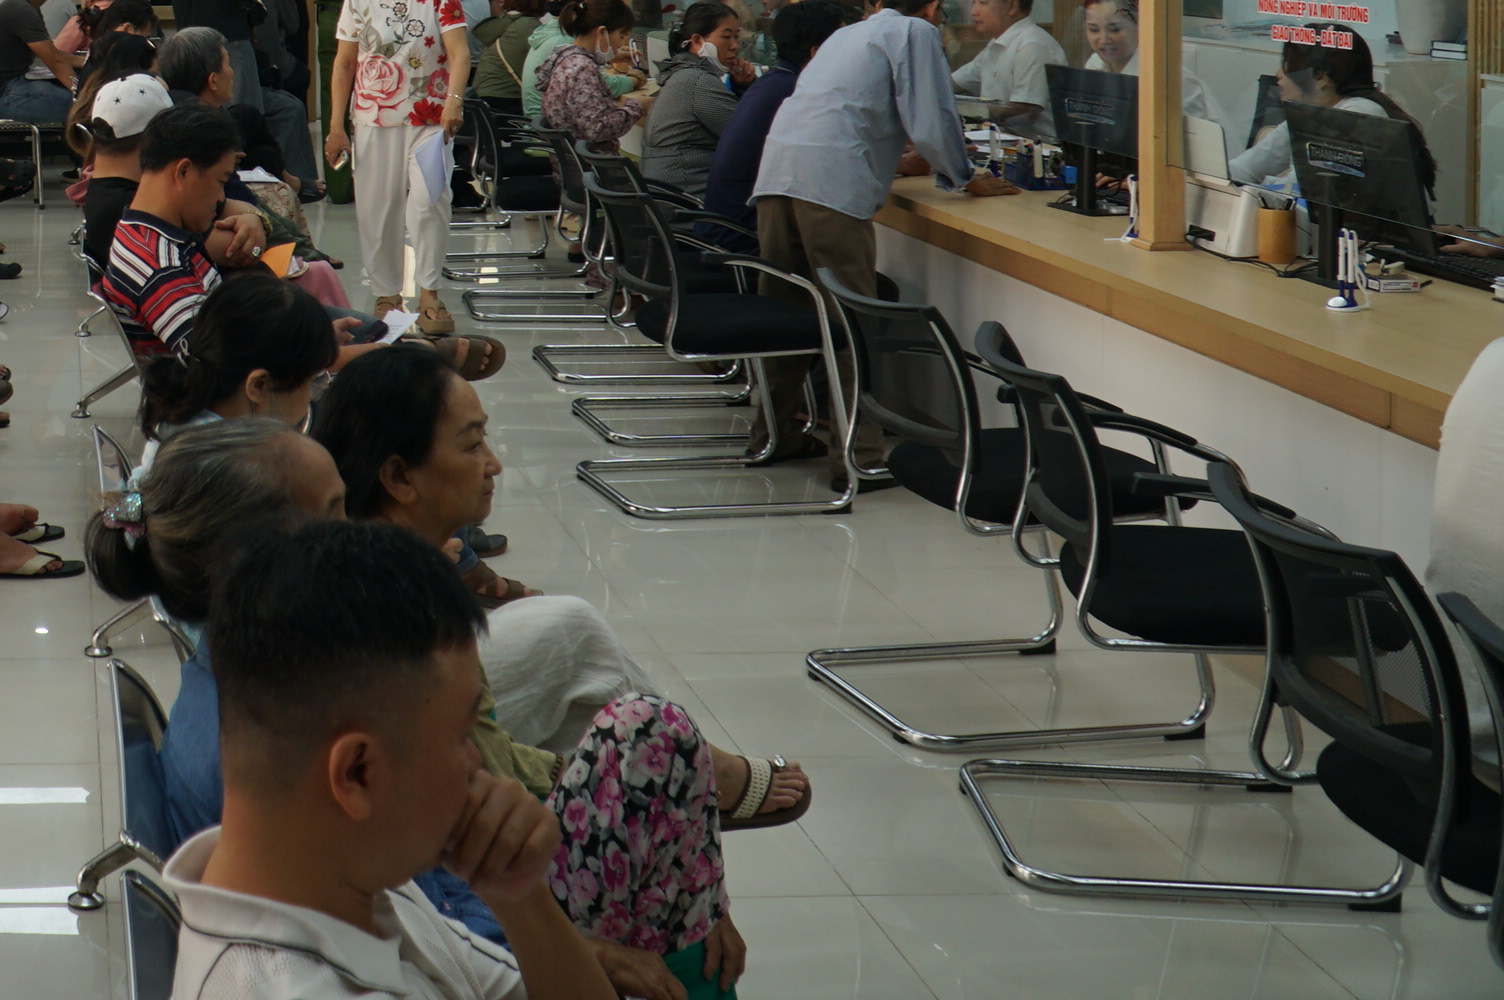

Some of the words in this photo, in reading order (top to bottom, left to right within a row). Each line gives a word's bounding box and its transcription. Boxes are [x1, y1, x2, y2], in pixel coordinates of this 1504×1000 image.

[1308, 0, 1318, 18] VÀ
[1320, 1, 1335, 20] MÔI
[1337, 2, 1369, 24] TRƯỜNG
[1271, 25, 1289, 42] GIAO
[1290, 24, 1315, 45] THÔNG
[1321, 25, 1336, 47] ĐẤT
[1337, 31, 1353, 50] ĐAI
